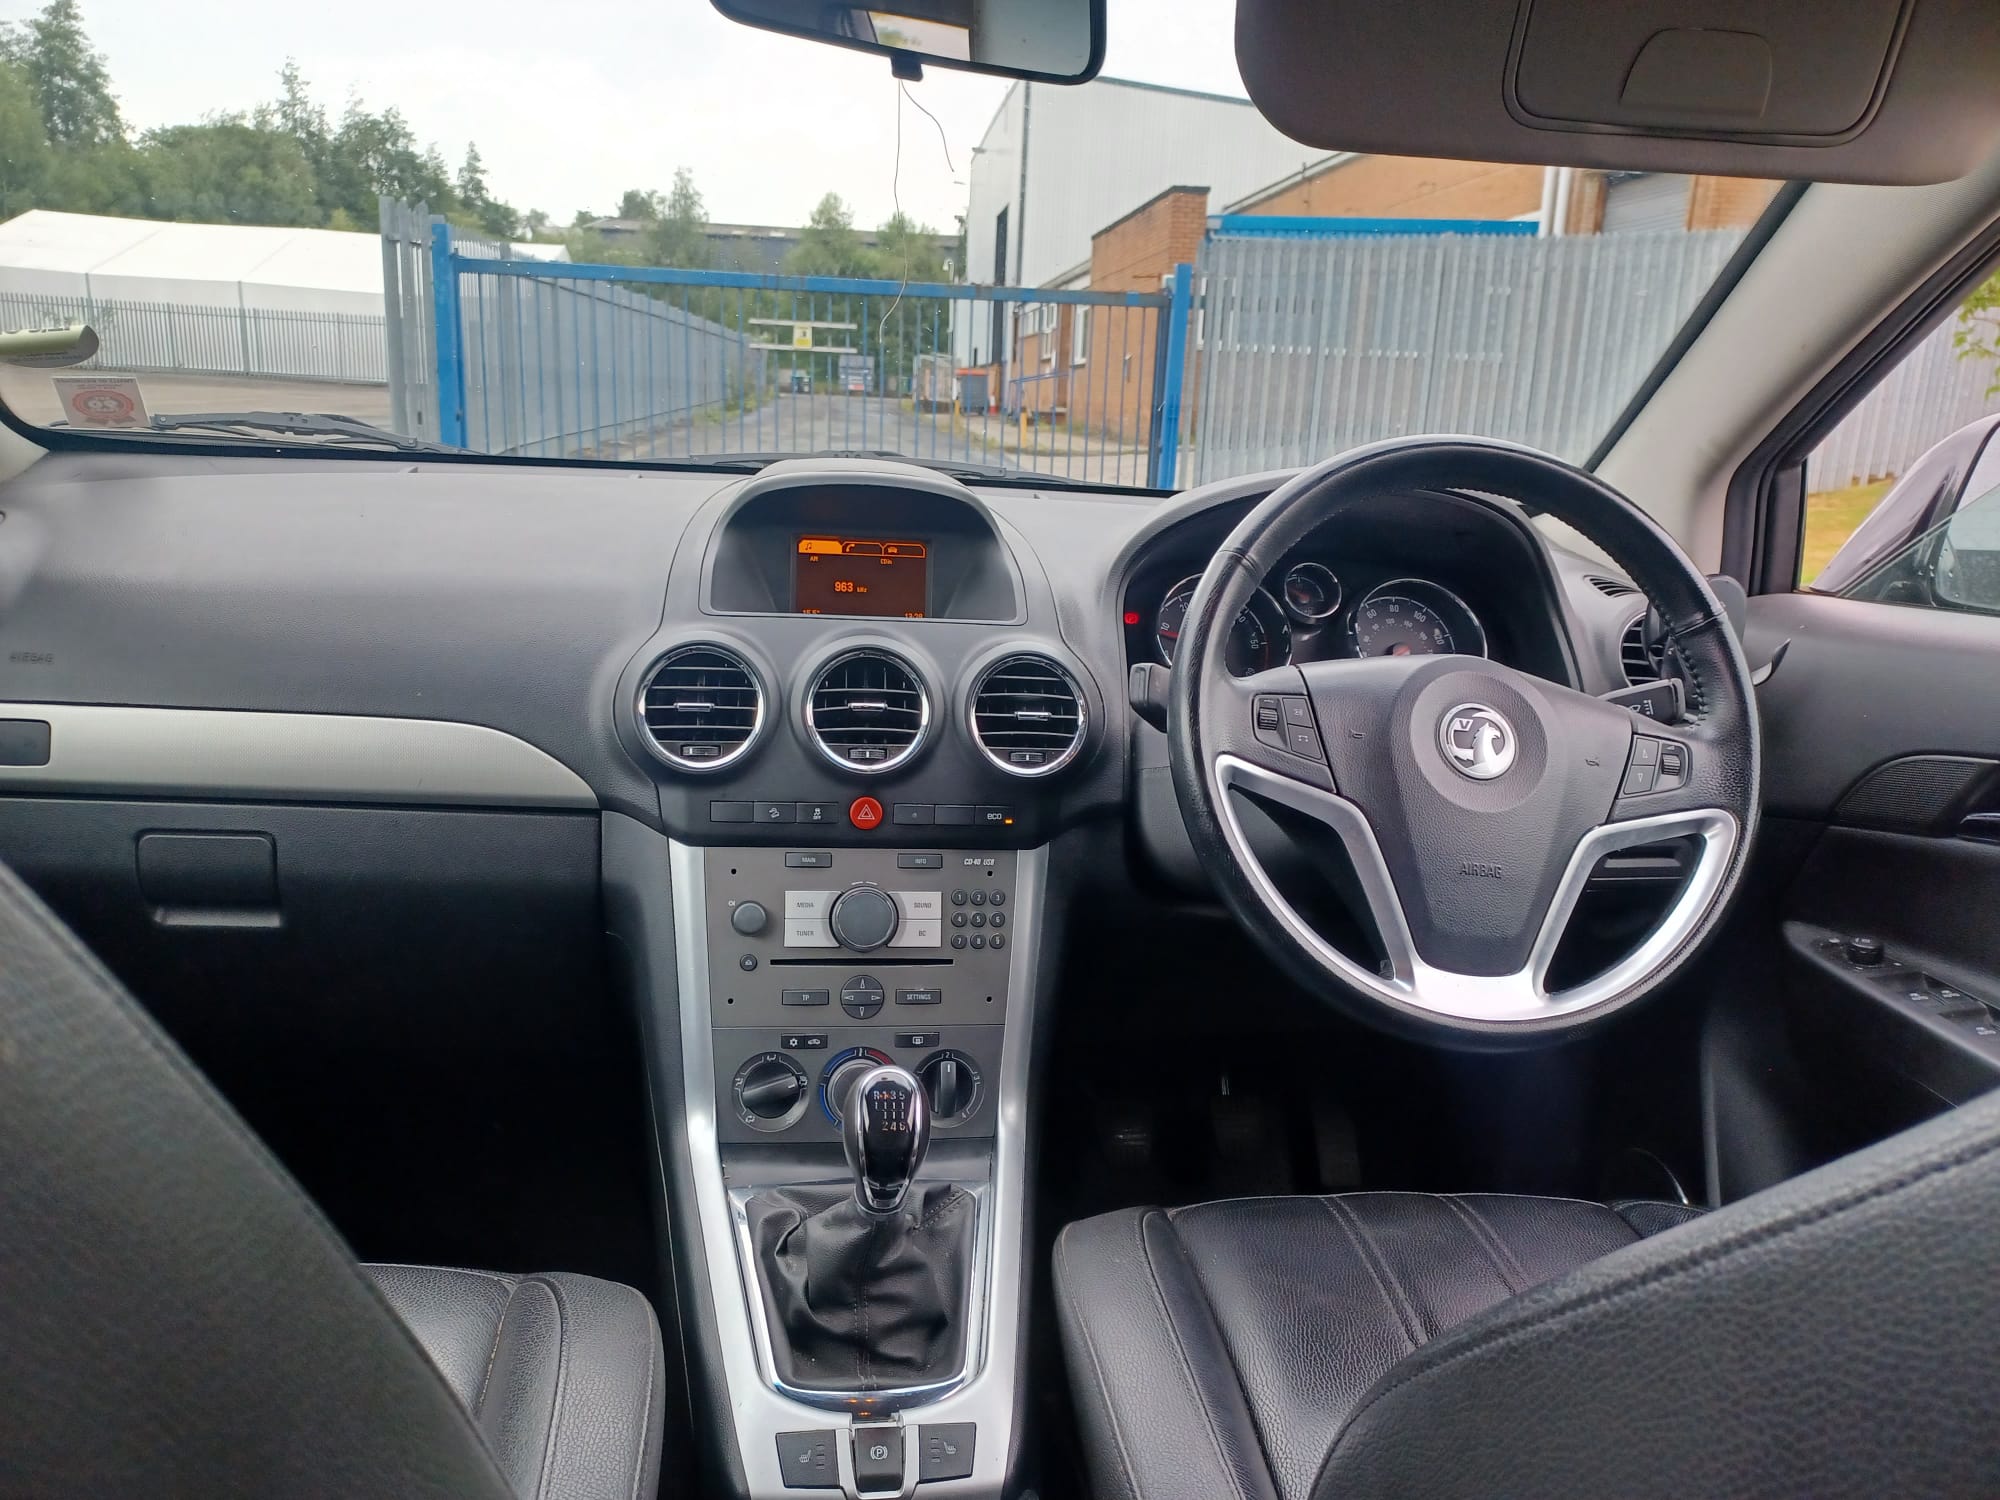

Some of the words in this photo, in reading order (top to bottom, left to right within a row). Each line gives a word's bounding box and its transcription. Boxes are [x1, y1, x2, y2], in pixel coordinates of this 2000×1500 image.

[834, 581, 854, 592] 963
[1367, 609, 1377, 618] 60
[1413, 611, 1426, 622] 100
[983, 858, 995, 866] USB
[1459, 862, 1502, 879] AIRBAG
[873, 1090, 880, 1100] R
